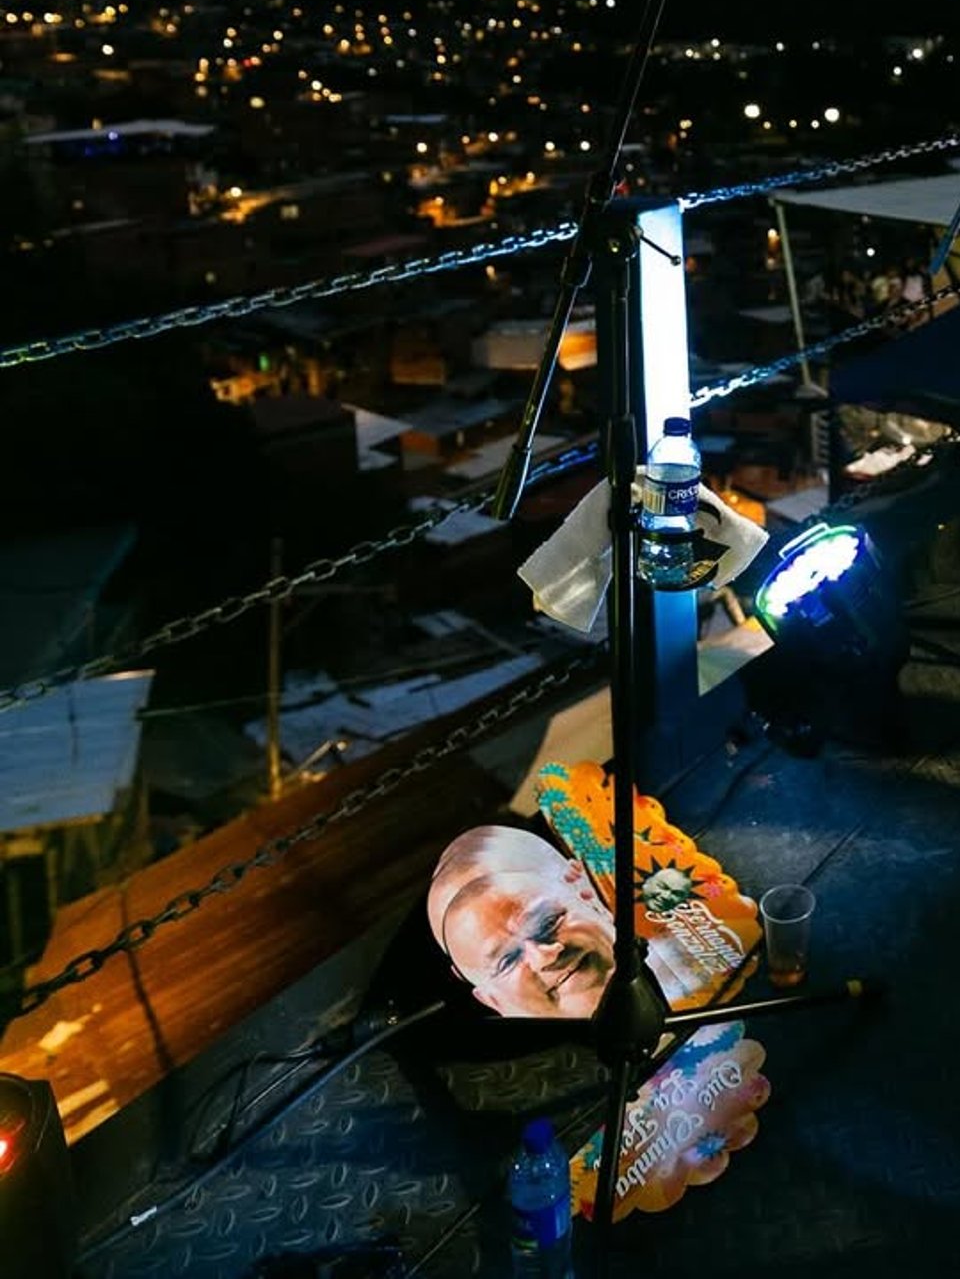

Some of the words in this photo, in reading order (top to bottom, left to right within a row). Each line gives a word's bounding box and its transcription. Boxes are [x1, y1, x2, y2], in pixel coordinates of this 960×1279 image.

[652, 1068, 699, 1112] La
[698, 1060, 742, 1112] Qué
[615, 1109, 704, 1197] Chimba
